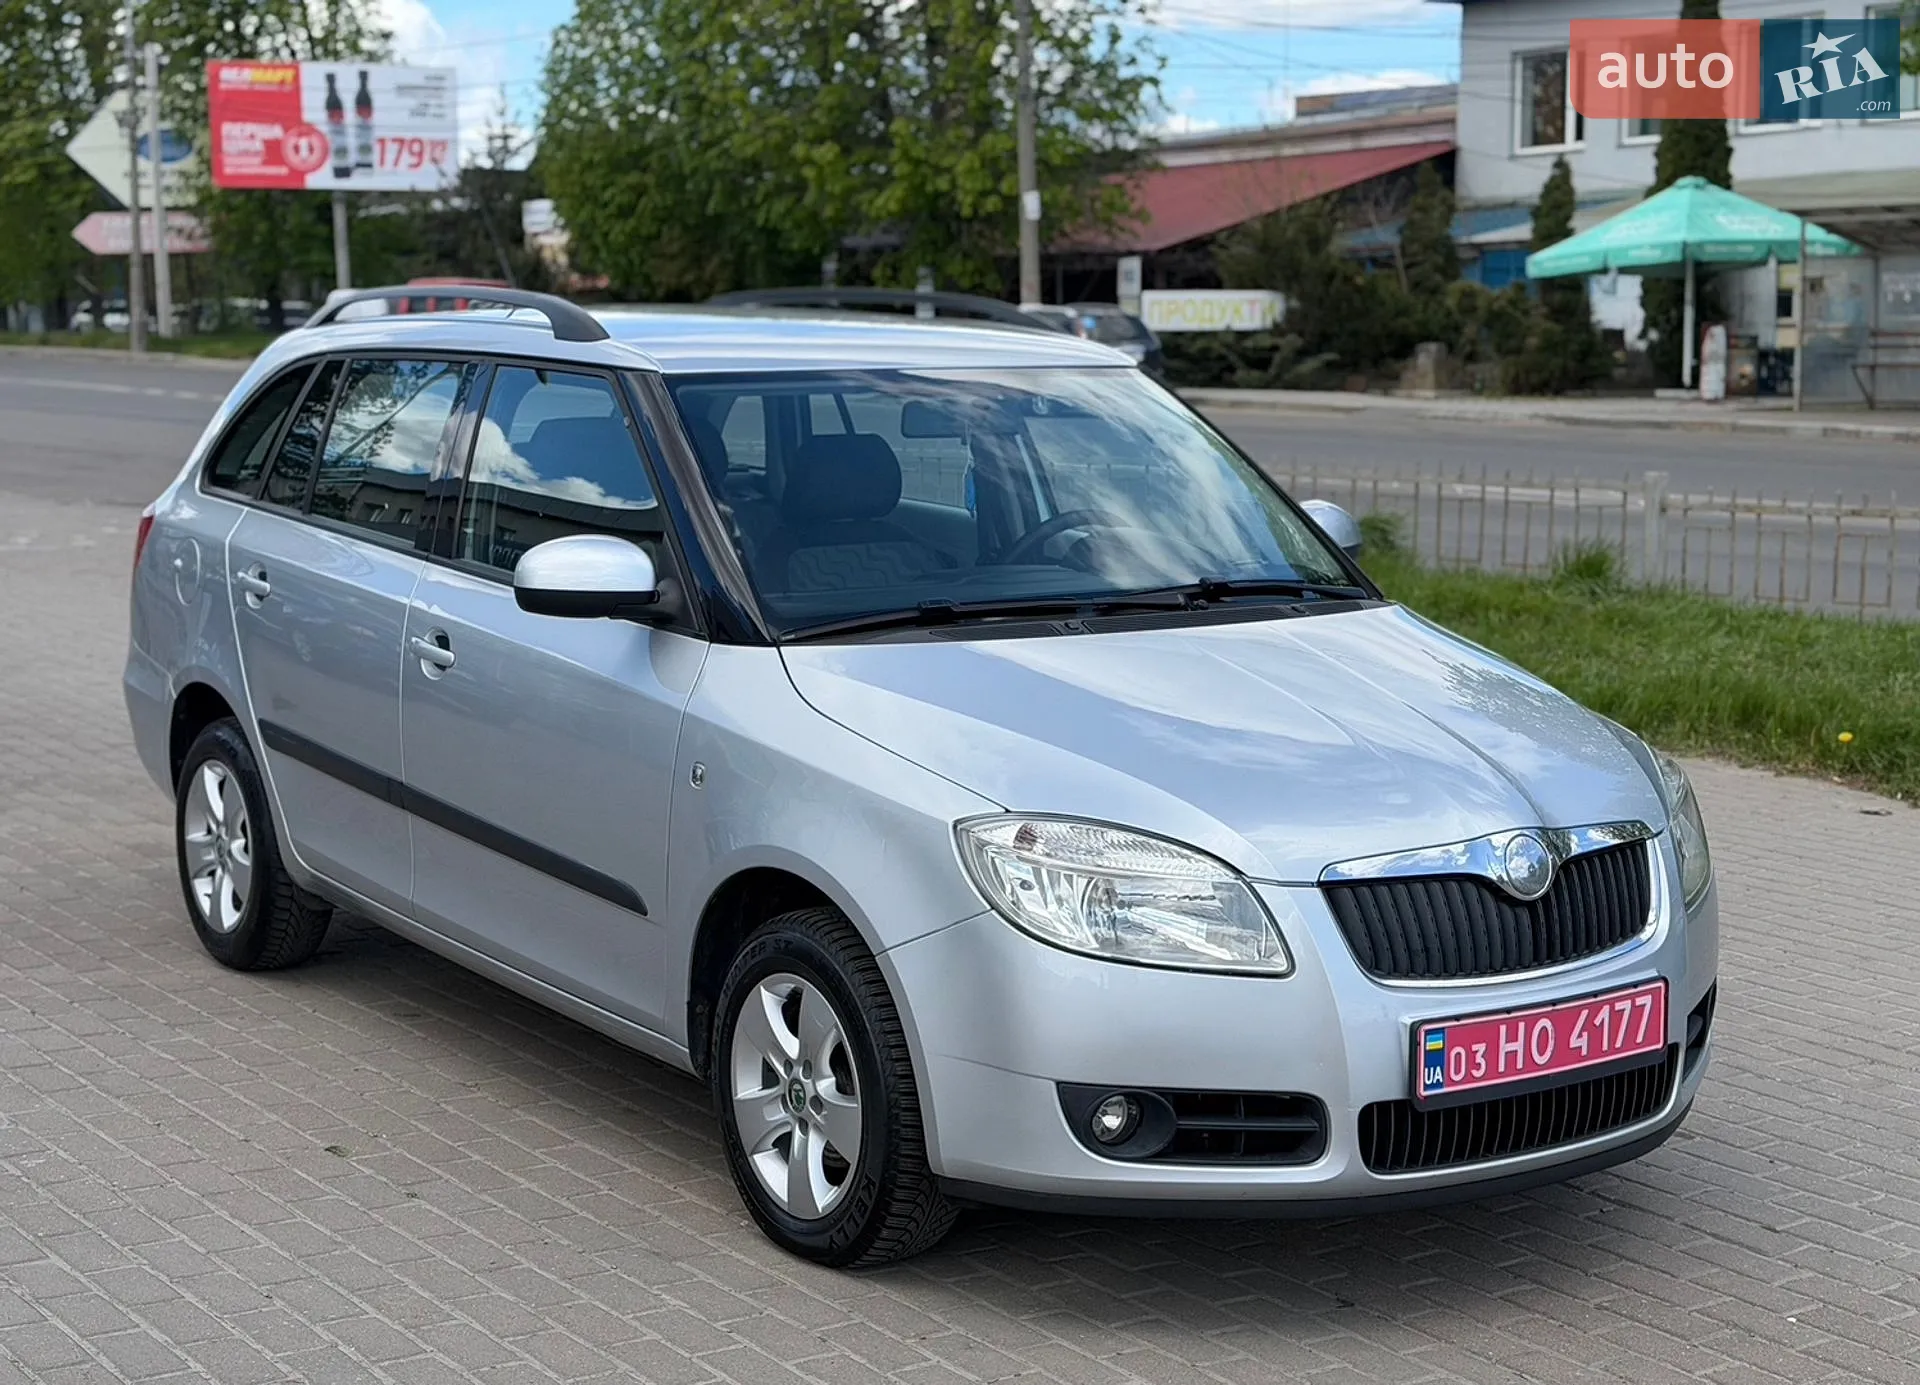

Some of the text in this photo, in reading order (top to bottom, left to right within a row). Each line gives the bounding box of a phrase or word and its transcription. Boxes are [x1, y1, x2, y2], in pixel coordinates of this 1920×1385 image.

[376, 137, 424, 168] 179
[1449, 993, 1653, 1083] 03 HO 4177
[1424, 1066, 1443, 1086] UA
